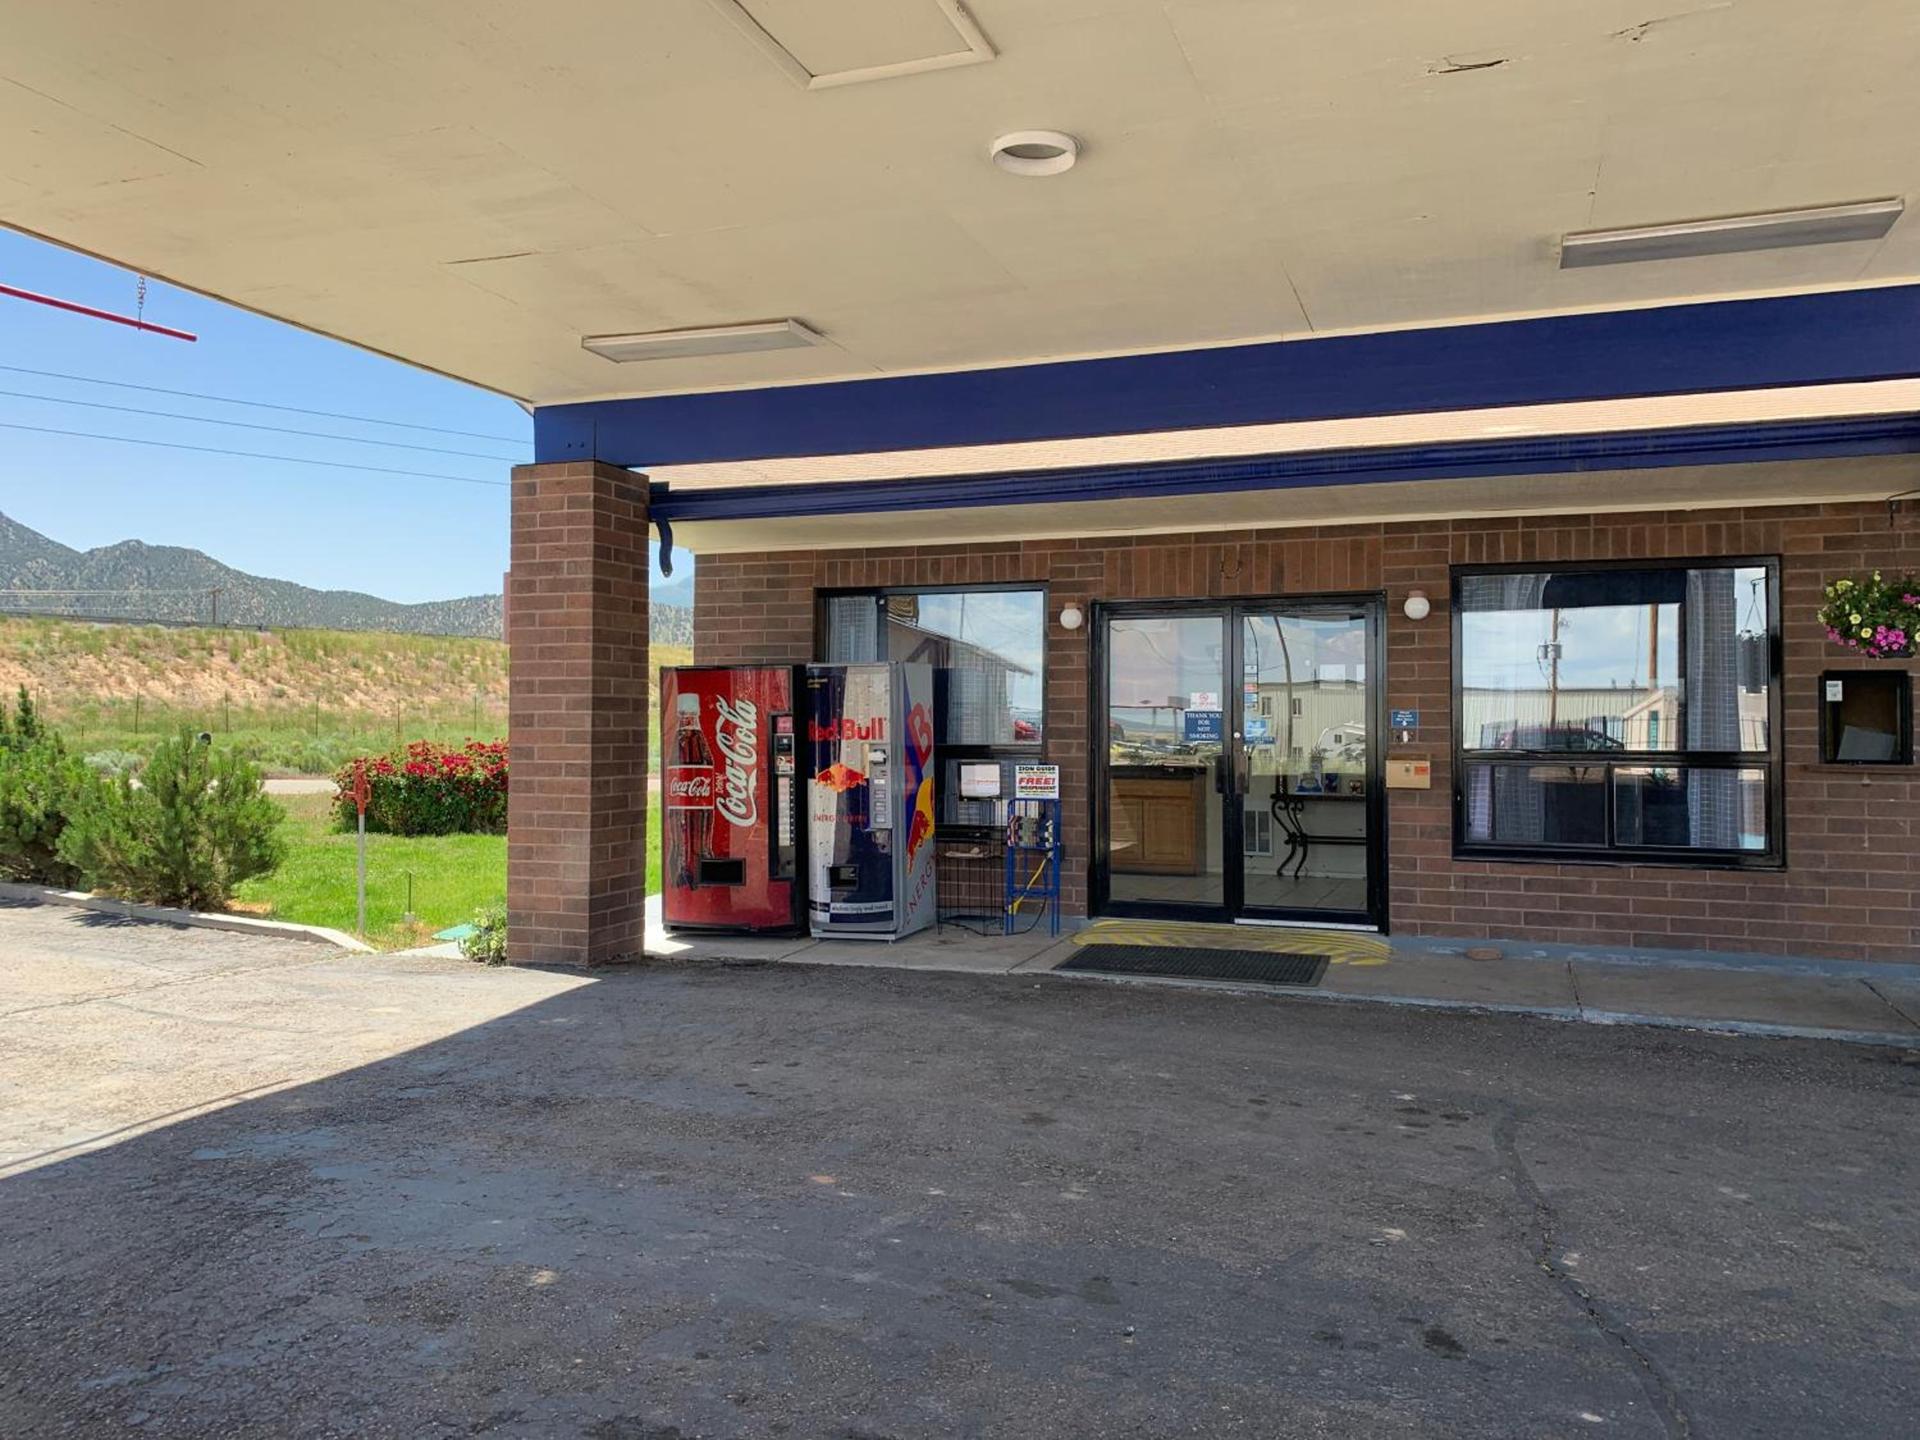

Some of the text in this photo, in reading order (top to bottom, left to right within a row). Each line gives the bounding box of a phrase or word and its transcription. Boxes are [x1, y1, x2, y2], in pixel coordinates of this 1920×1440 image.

[842, 717, 884, 740] Bull
[716, 694, 757, 827] Coca-Cola
[671, 777, 711, 797] Coca-Cola
[1019, 777, 1056, 785] FREE!
